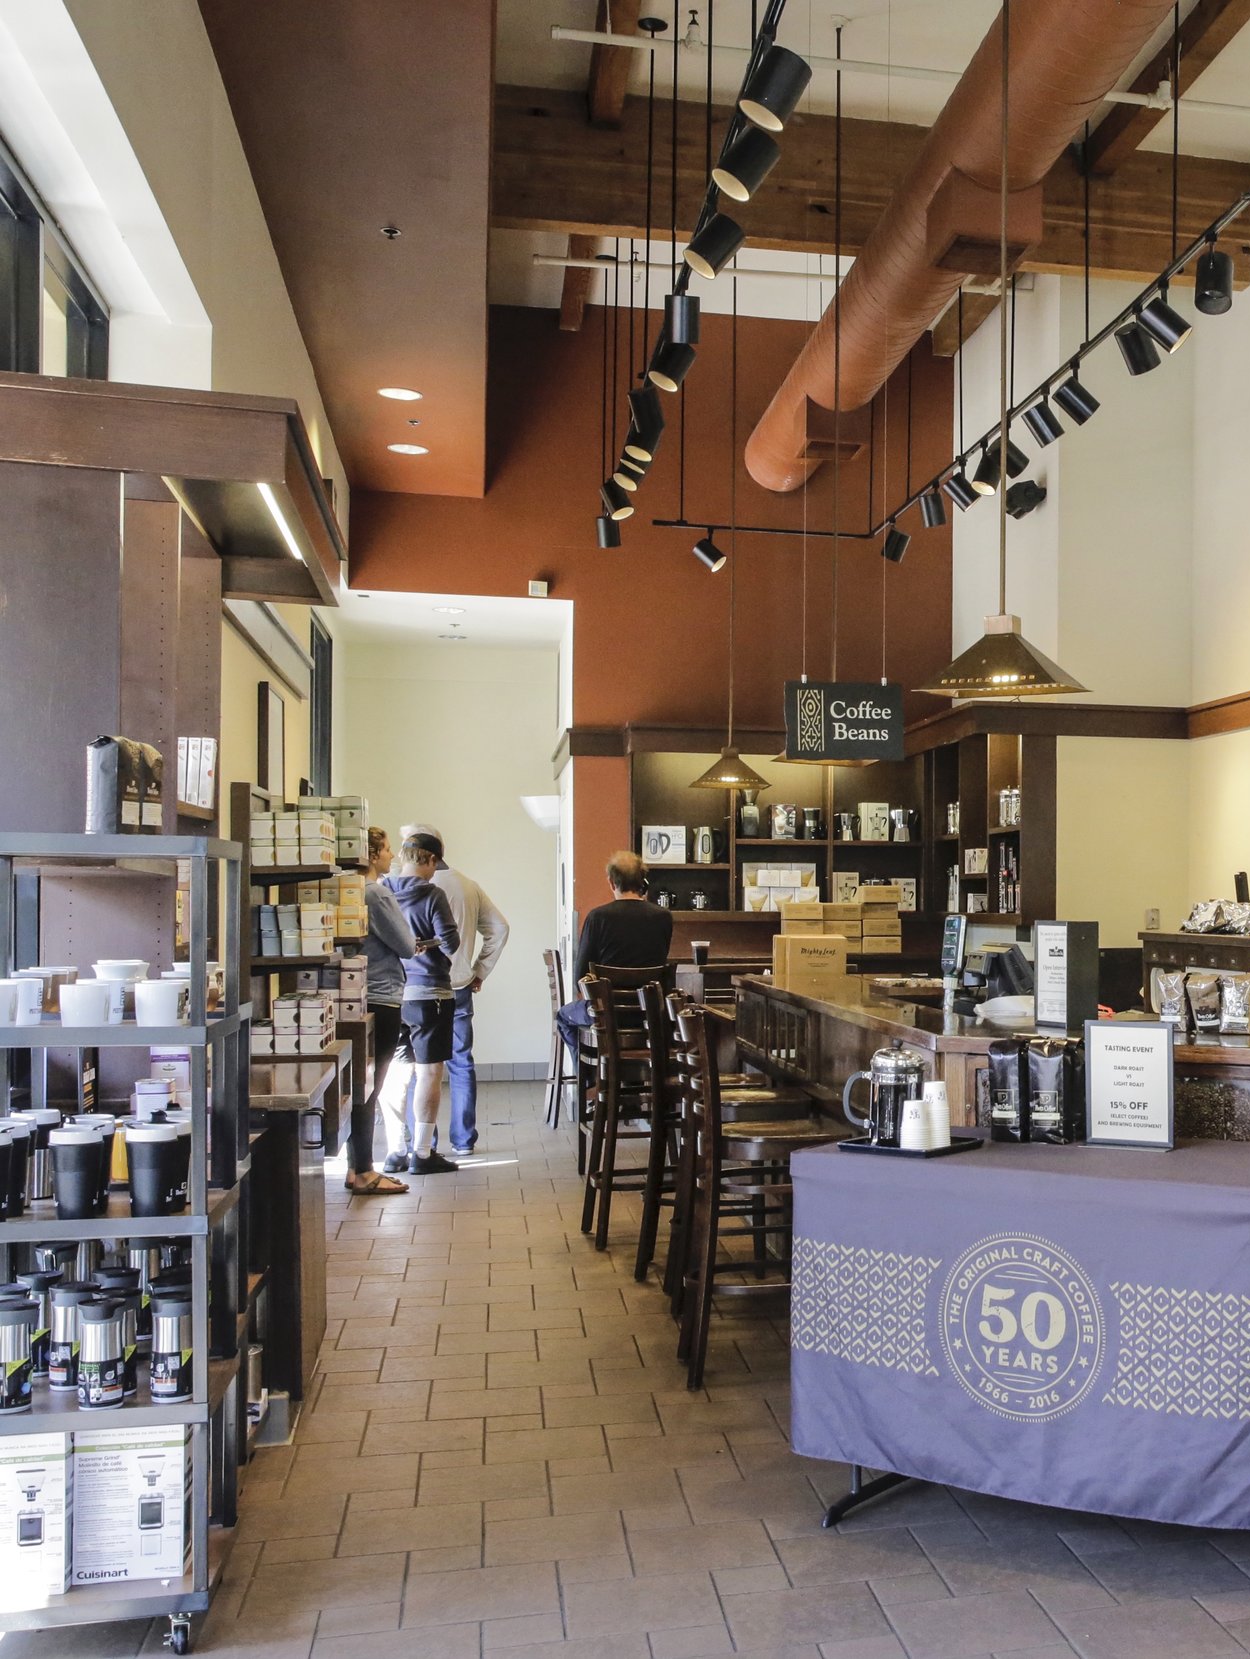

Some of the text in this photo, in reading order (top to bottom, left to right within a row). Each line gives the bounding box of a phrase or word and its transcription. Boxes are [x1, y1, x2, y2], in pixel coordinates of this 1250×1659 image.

[830, 700, 891, 720] Coffee
[832, 722, 888, 740] Beans
[1104, 1044, 1131, 1052] TASTING
[1110, 1101, 1149, 1110] 15% OFF
[950, 1246, 1094, 1344] THE ORIGINAL CRAFT COFFEE
[978, 1283, 1066, 1350] 50
[981, 1344, 1058, 1374] YEARS
[979, 1377, 1060, 1409] 1966 2016
[76, 1568, 128, 1580] Cuisinart
